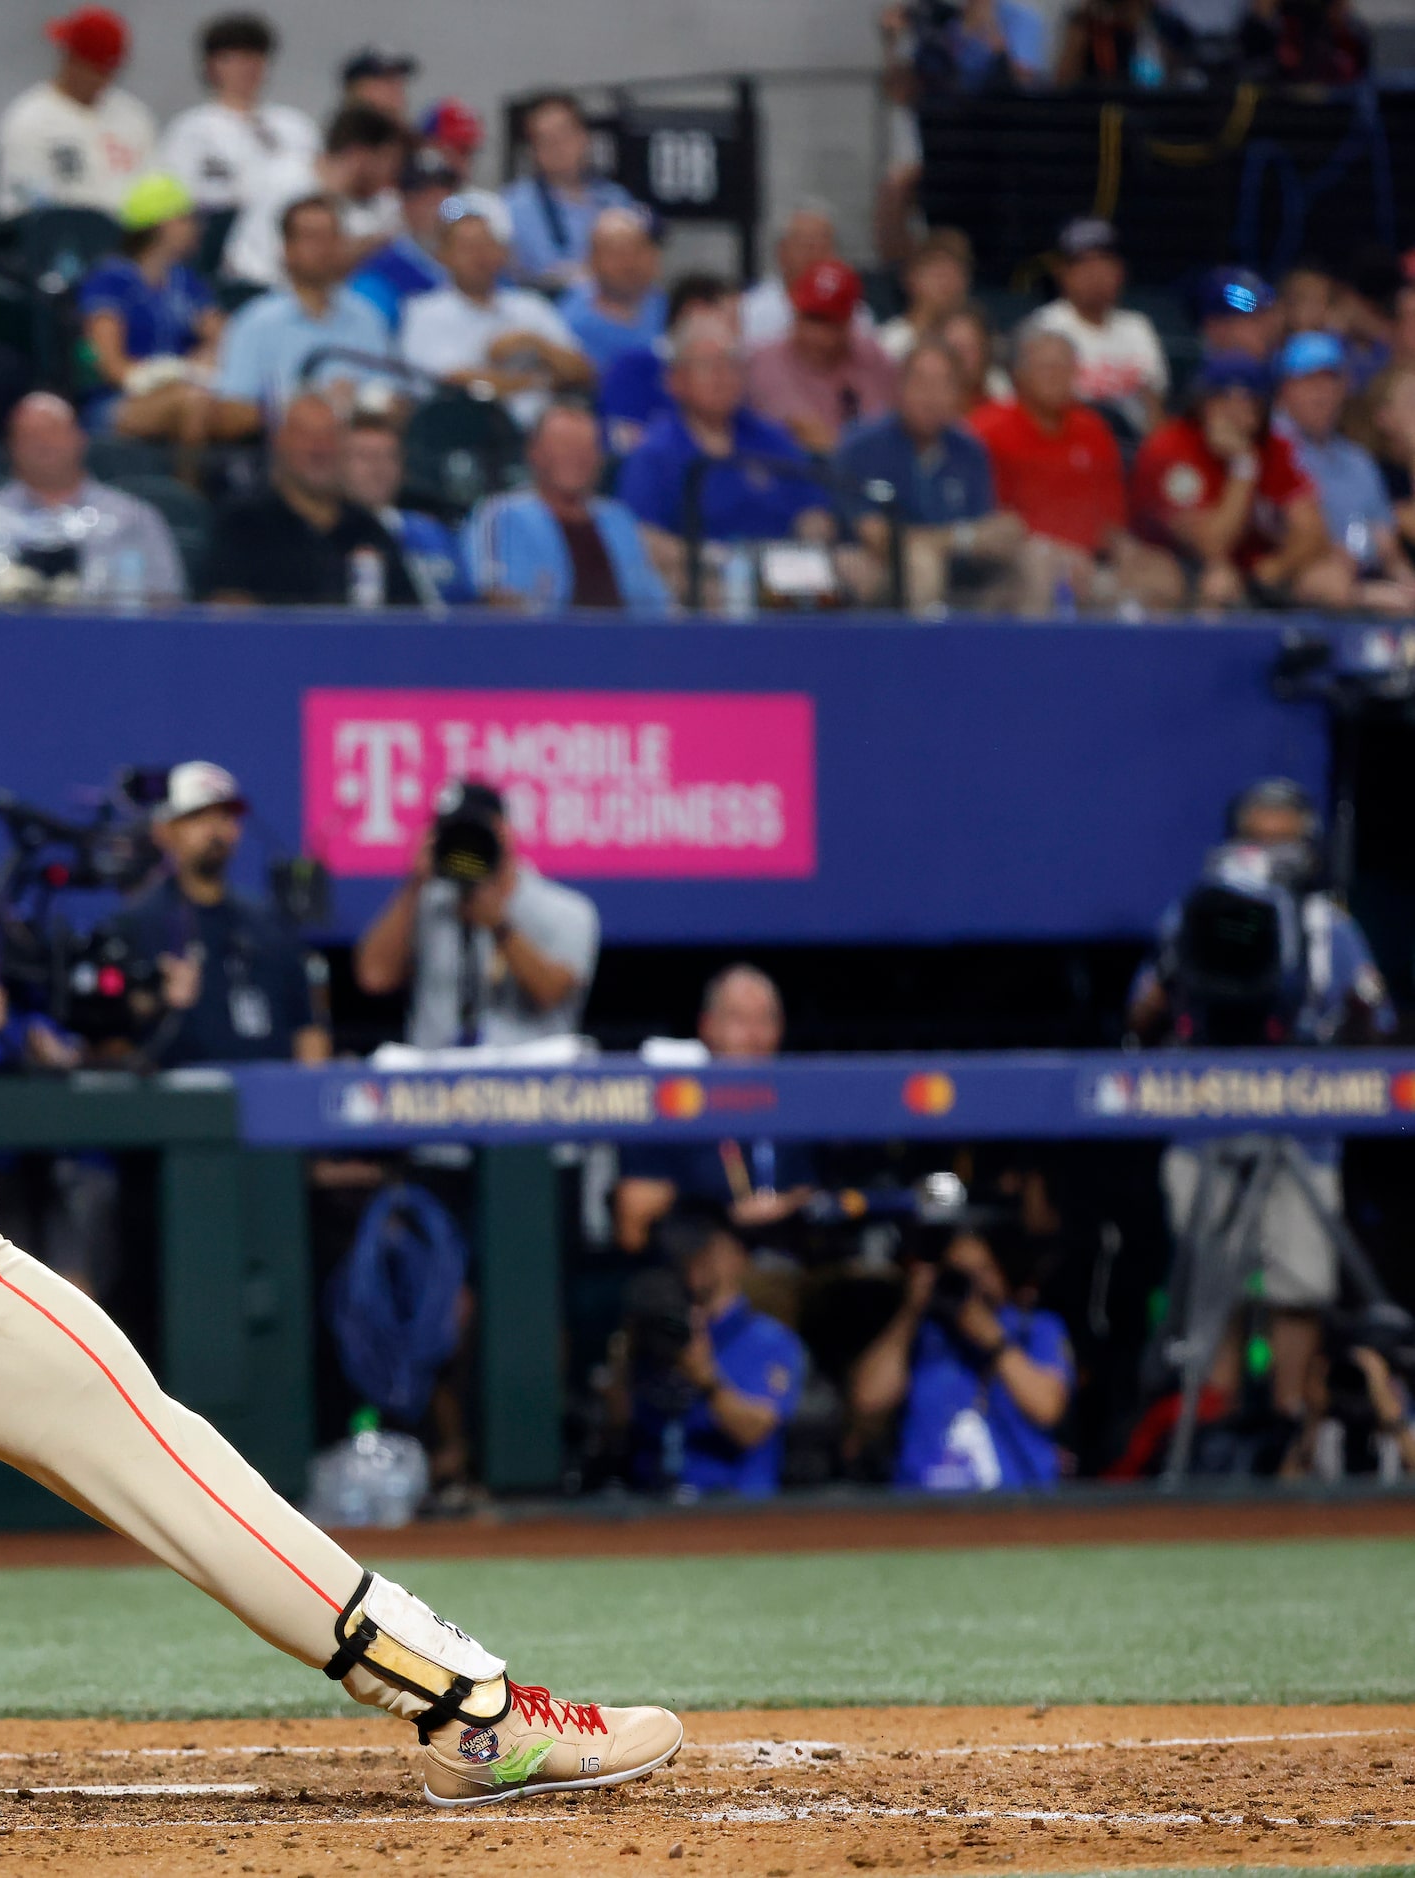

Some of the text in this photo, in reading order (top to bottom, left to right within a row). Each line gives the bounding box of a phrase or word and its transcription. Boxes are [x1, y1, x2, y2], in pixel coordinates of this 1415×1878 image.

[439, 720, 672, 778] T-MOBILE
[545, 782, 785, 847] BUSINESS
[548, 1074, 654, 1125] GAME
[1287, 1064, 1386, 1118] GAME
[469, 1737, 493, 1755] GAME
[579, 1757, 601, 1773] 16
